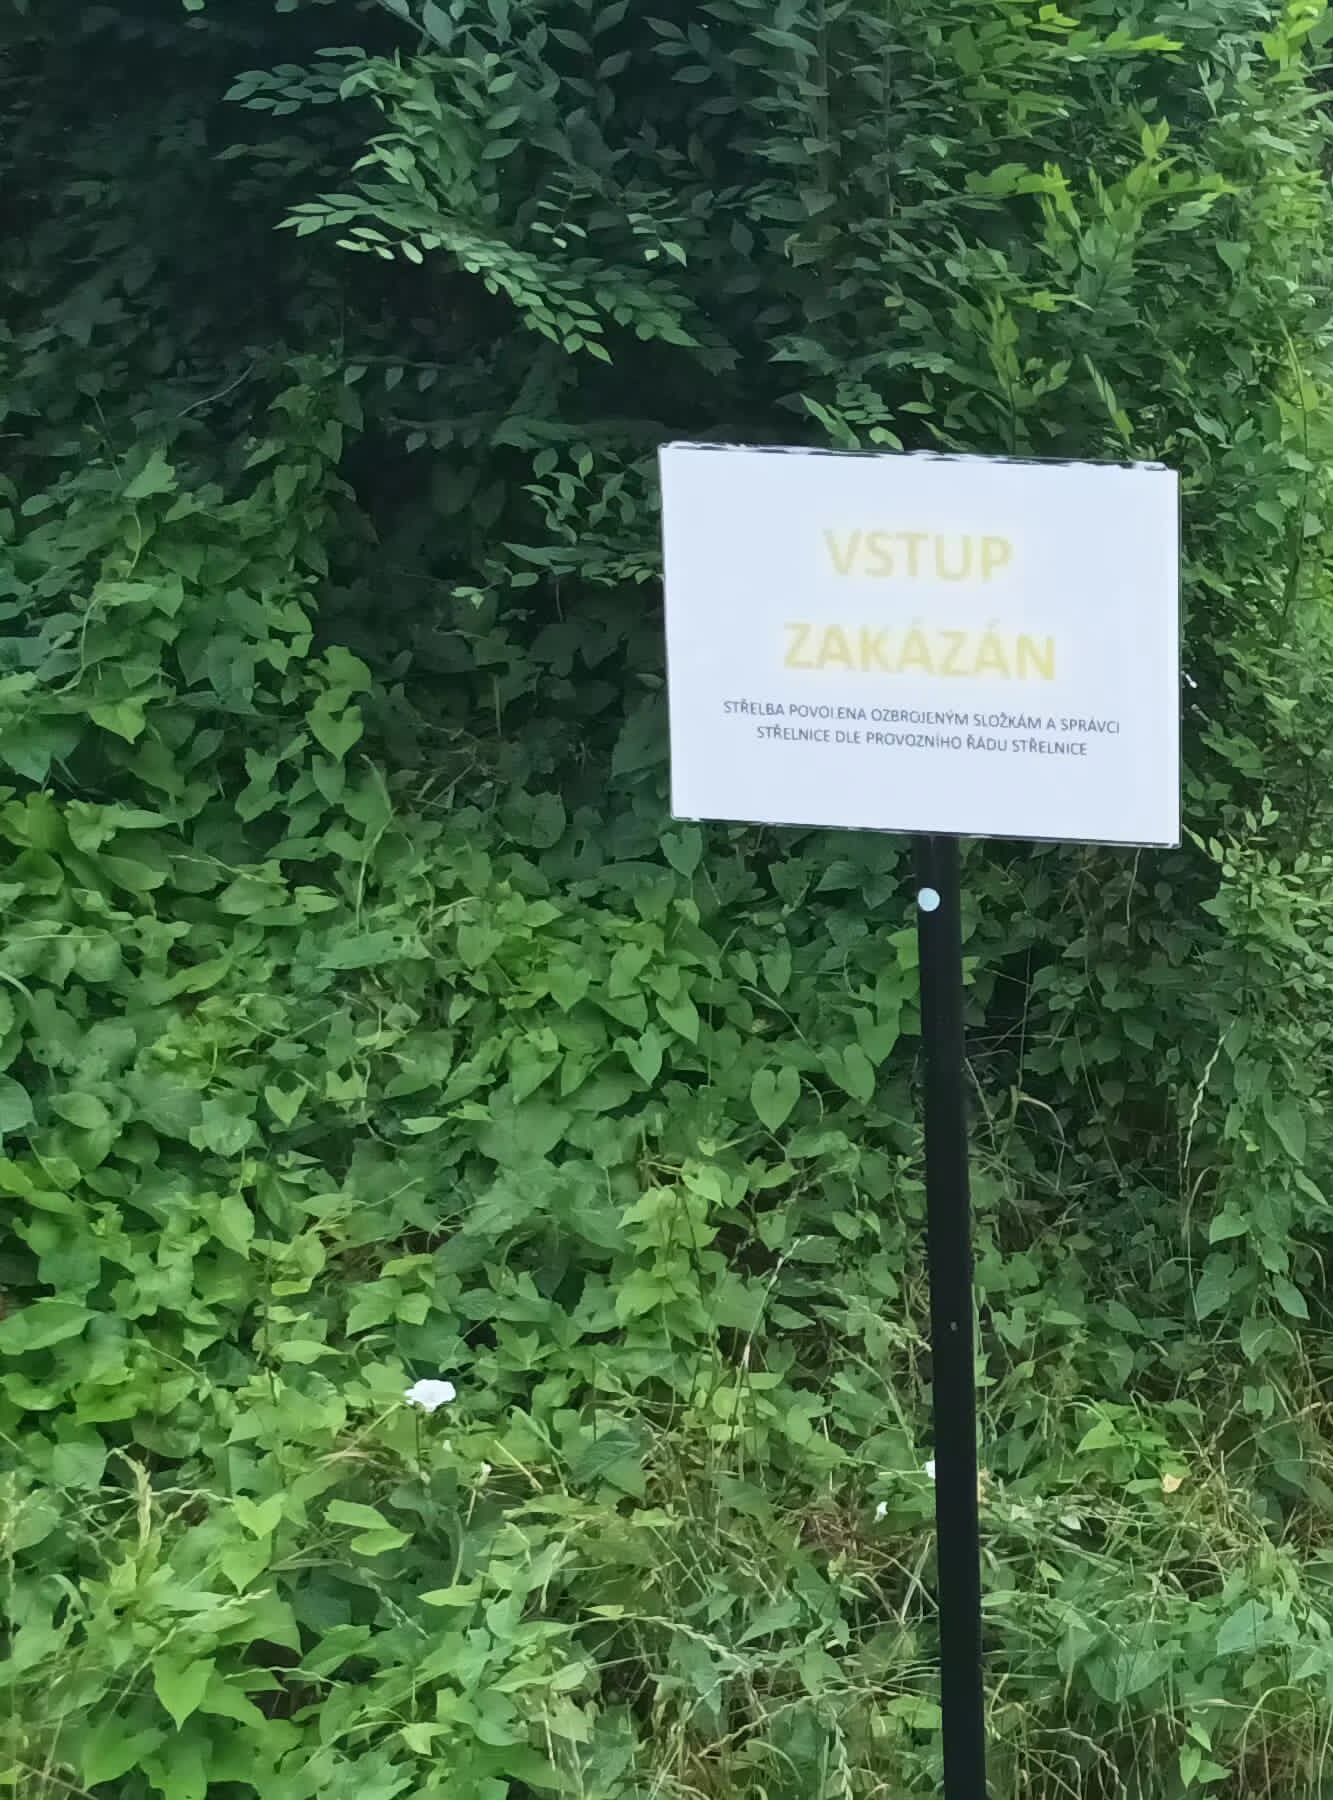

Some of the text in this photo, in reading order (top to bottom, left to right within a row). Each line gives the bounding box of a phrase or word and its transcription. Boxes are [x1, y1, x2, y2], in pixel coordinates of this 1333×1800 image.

[822, 527, 1013, 583] VSTUP
[783, 617, 1056, 682] ZAKÁZÁN
[723, 698, 1120, 734] STŘELBA POVOLENA OZBROJENÝM SLOŽKÁM A SPRÁVCI
[757, 724, 831, 743] STŘELNICE
[834, 730, 862, 745] DLE
[866, 731, 962, 750] PROVOZNÍHO
[1012, 737, 1088, 756] STŘELNICE
